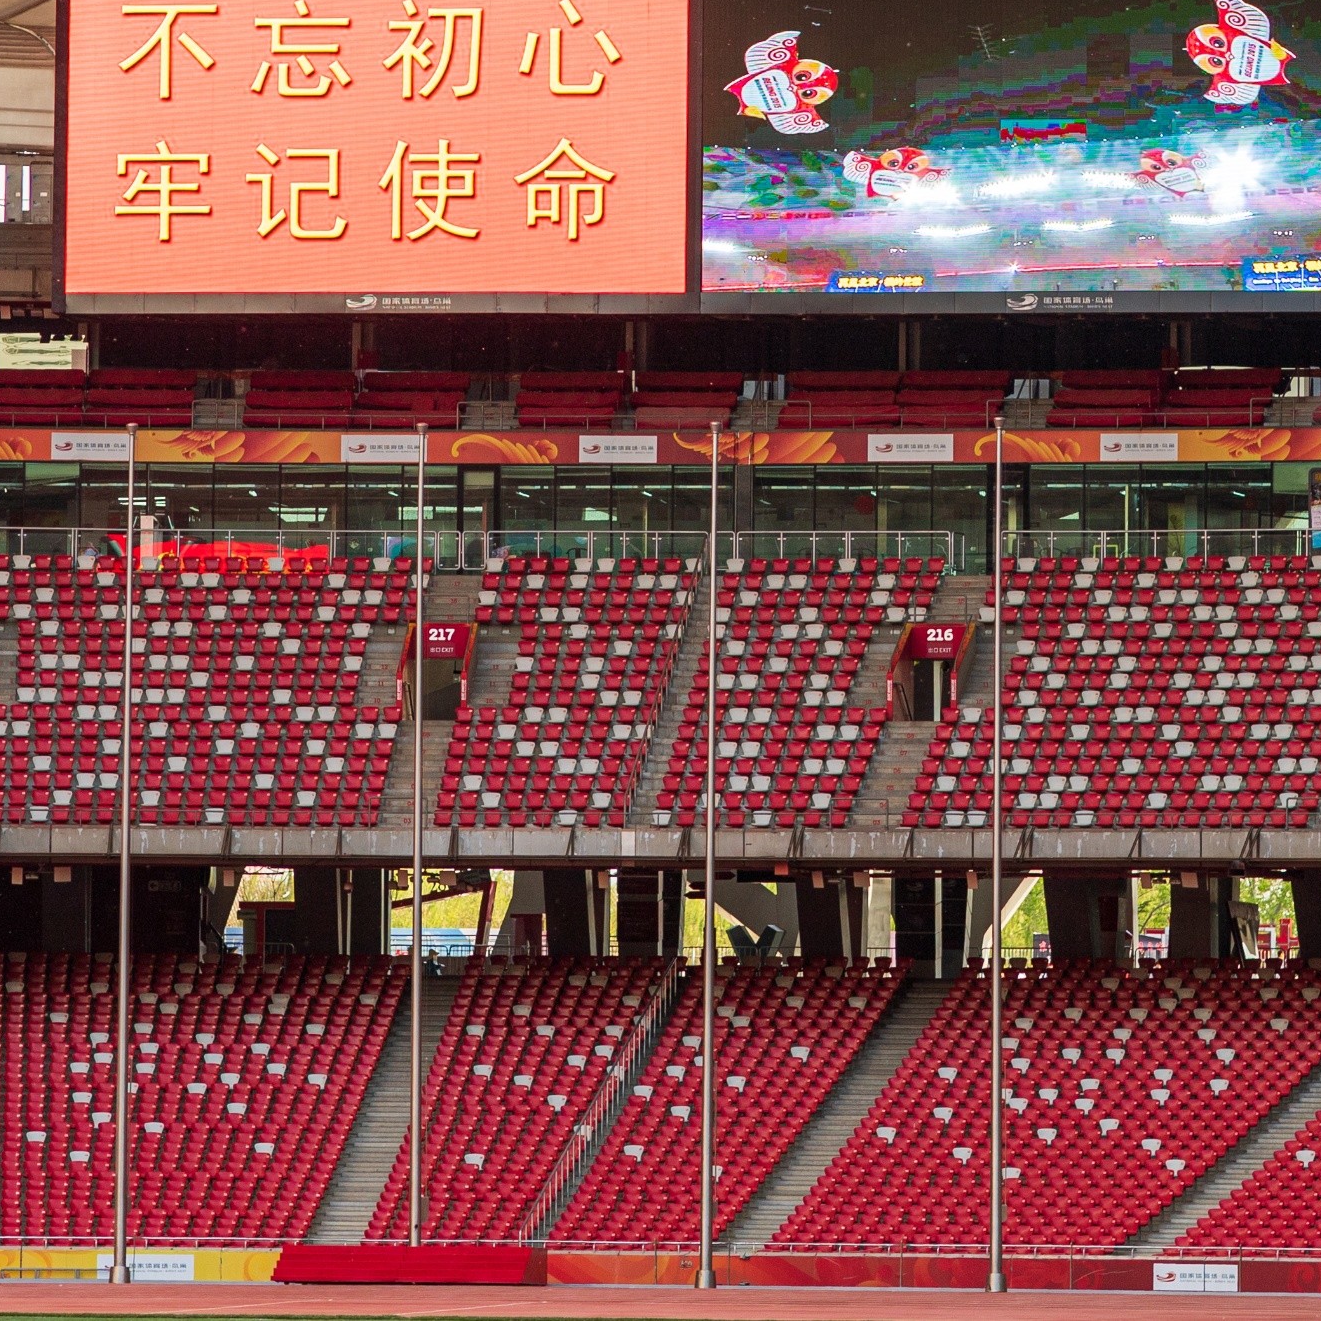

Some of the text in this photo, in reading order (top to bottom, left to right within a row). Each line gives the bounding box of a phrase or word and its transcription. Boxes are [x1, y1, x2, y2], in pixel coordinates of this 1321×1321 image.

[114, 137, 620, 241] 牢记使命
[428, 628, 455, 641] 217
[926, 628, 954, 642] 216
